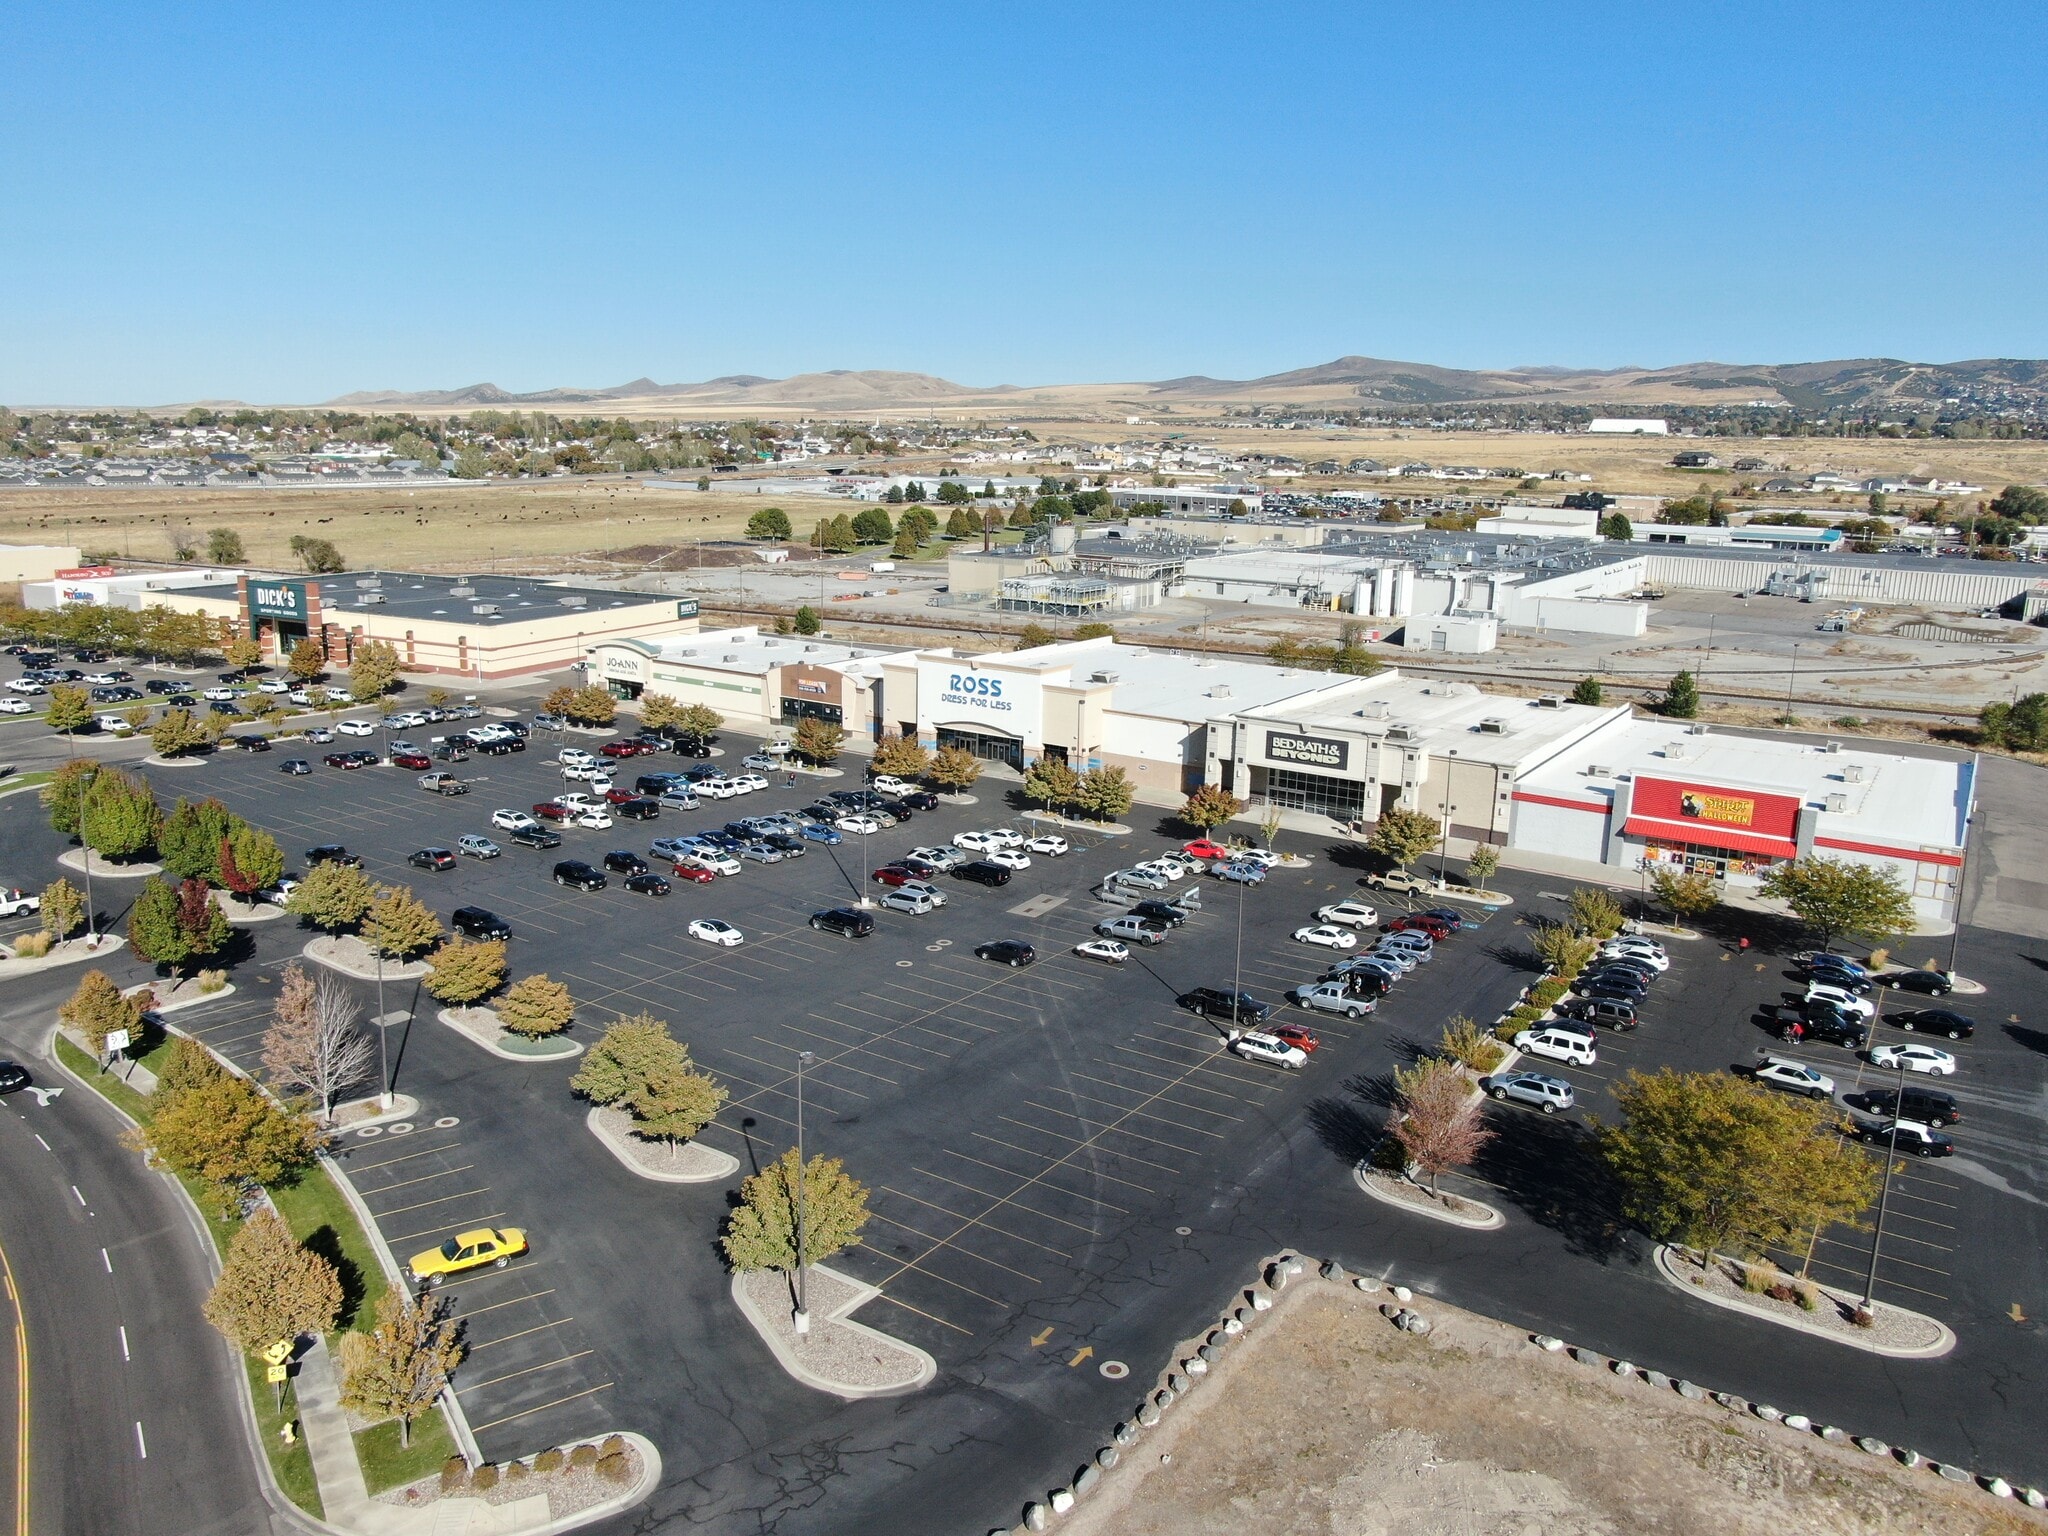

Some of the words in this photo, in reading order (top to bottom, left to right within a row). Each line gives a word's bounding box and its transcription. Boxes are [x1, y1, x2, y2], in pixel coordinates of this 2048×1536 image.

[257, 588, 296, 608] DICK'S
[950, 674, 1002, 697] ROSS
[941, 693, 968, 705] DRESS
[970, 697, 987, 708] FOR
[990, 700, 1012, 711] LESS
[1272, 736, 1296, 749] BED
[1296, 740, 1329, 755] BATH
[1329, 744, 1341, 756] &
[1271, 747, 1340, 765] BEYOND
[1705, 796, 1749, 813] SPIRIT
[1702, 810, 1748, 823] HALLOWEEN
[270, 1367, 284, 1376] 20
